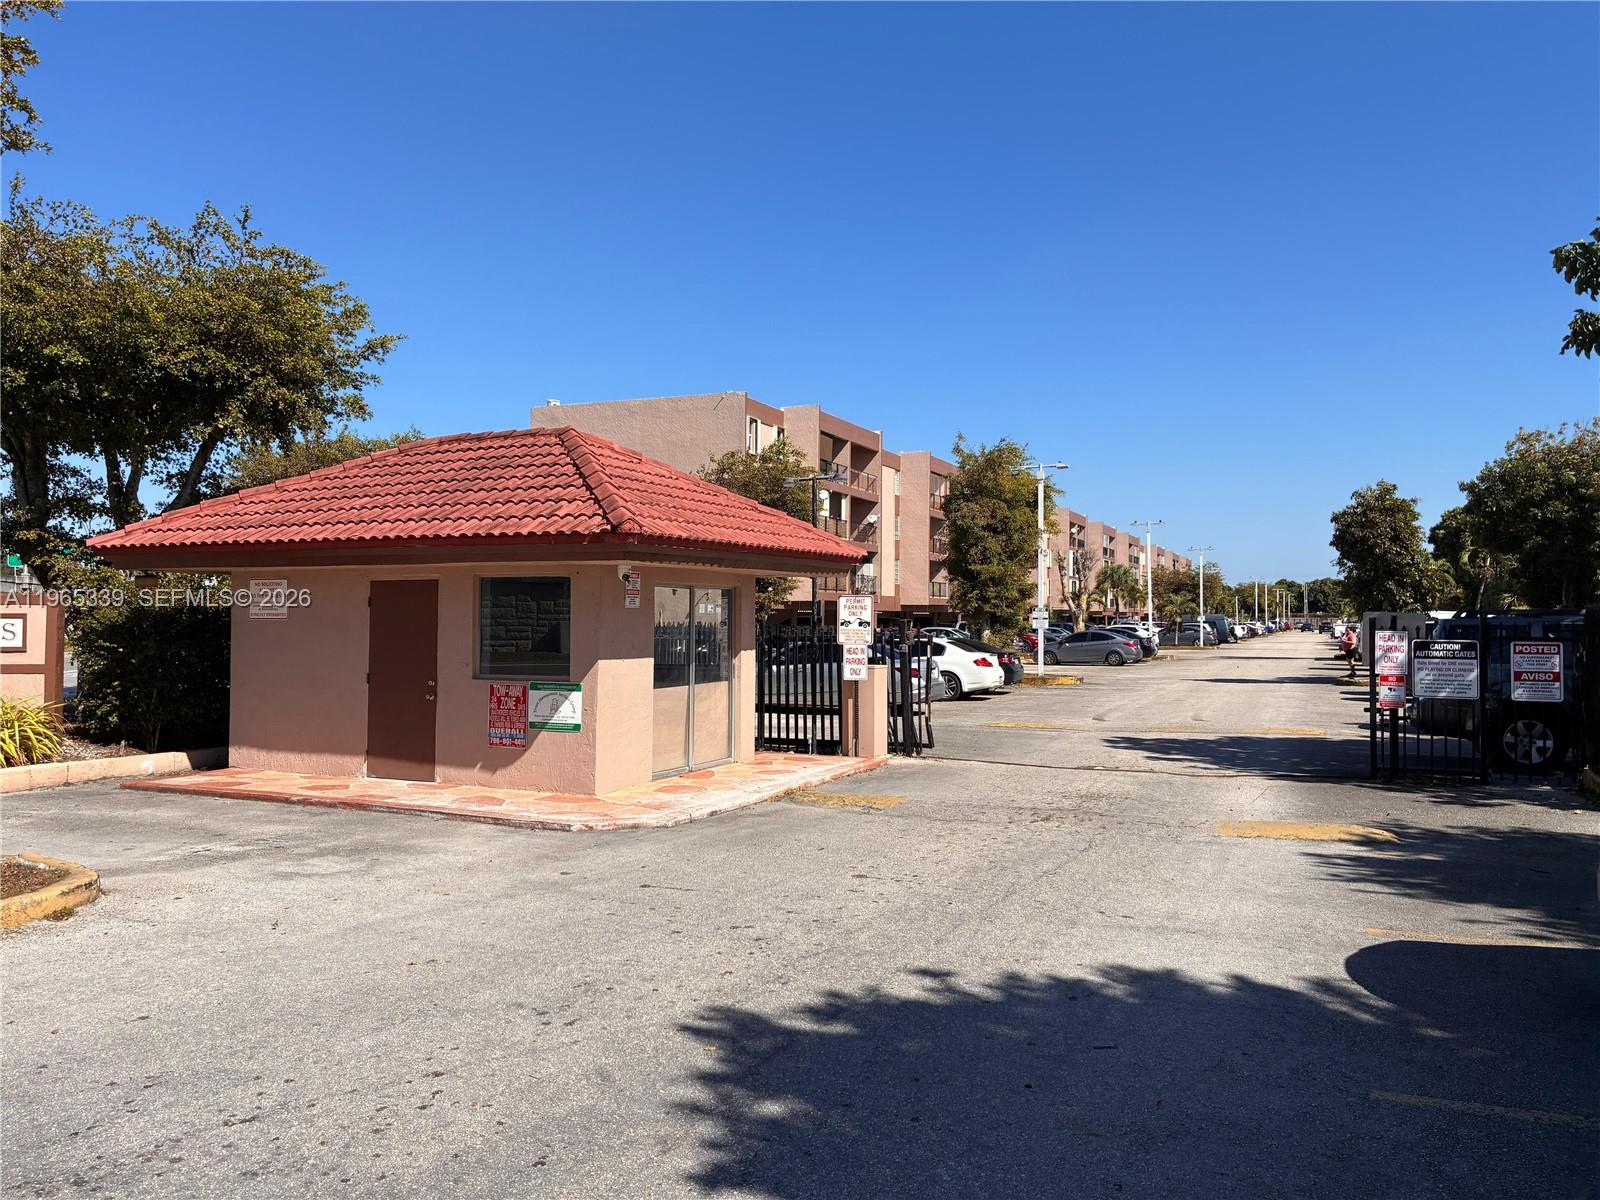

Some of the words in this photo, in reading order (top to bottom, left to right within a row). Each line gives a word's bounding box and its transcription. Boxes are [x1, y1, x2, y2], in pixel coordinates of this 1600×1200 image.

[1379, 634, 1395, 642] HEAD
[1398, 634, 1404, 642] IN
[846, 648, 859, 656] HEAD
[860, 648, 865, 656] IN
[1379, 645, 1404, 653] PARKING
[850, 668, 861, 676] ONLY
[494, 684, 523, 697] TOW-AWAY
[500, 697, 516, 710] ZONE
